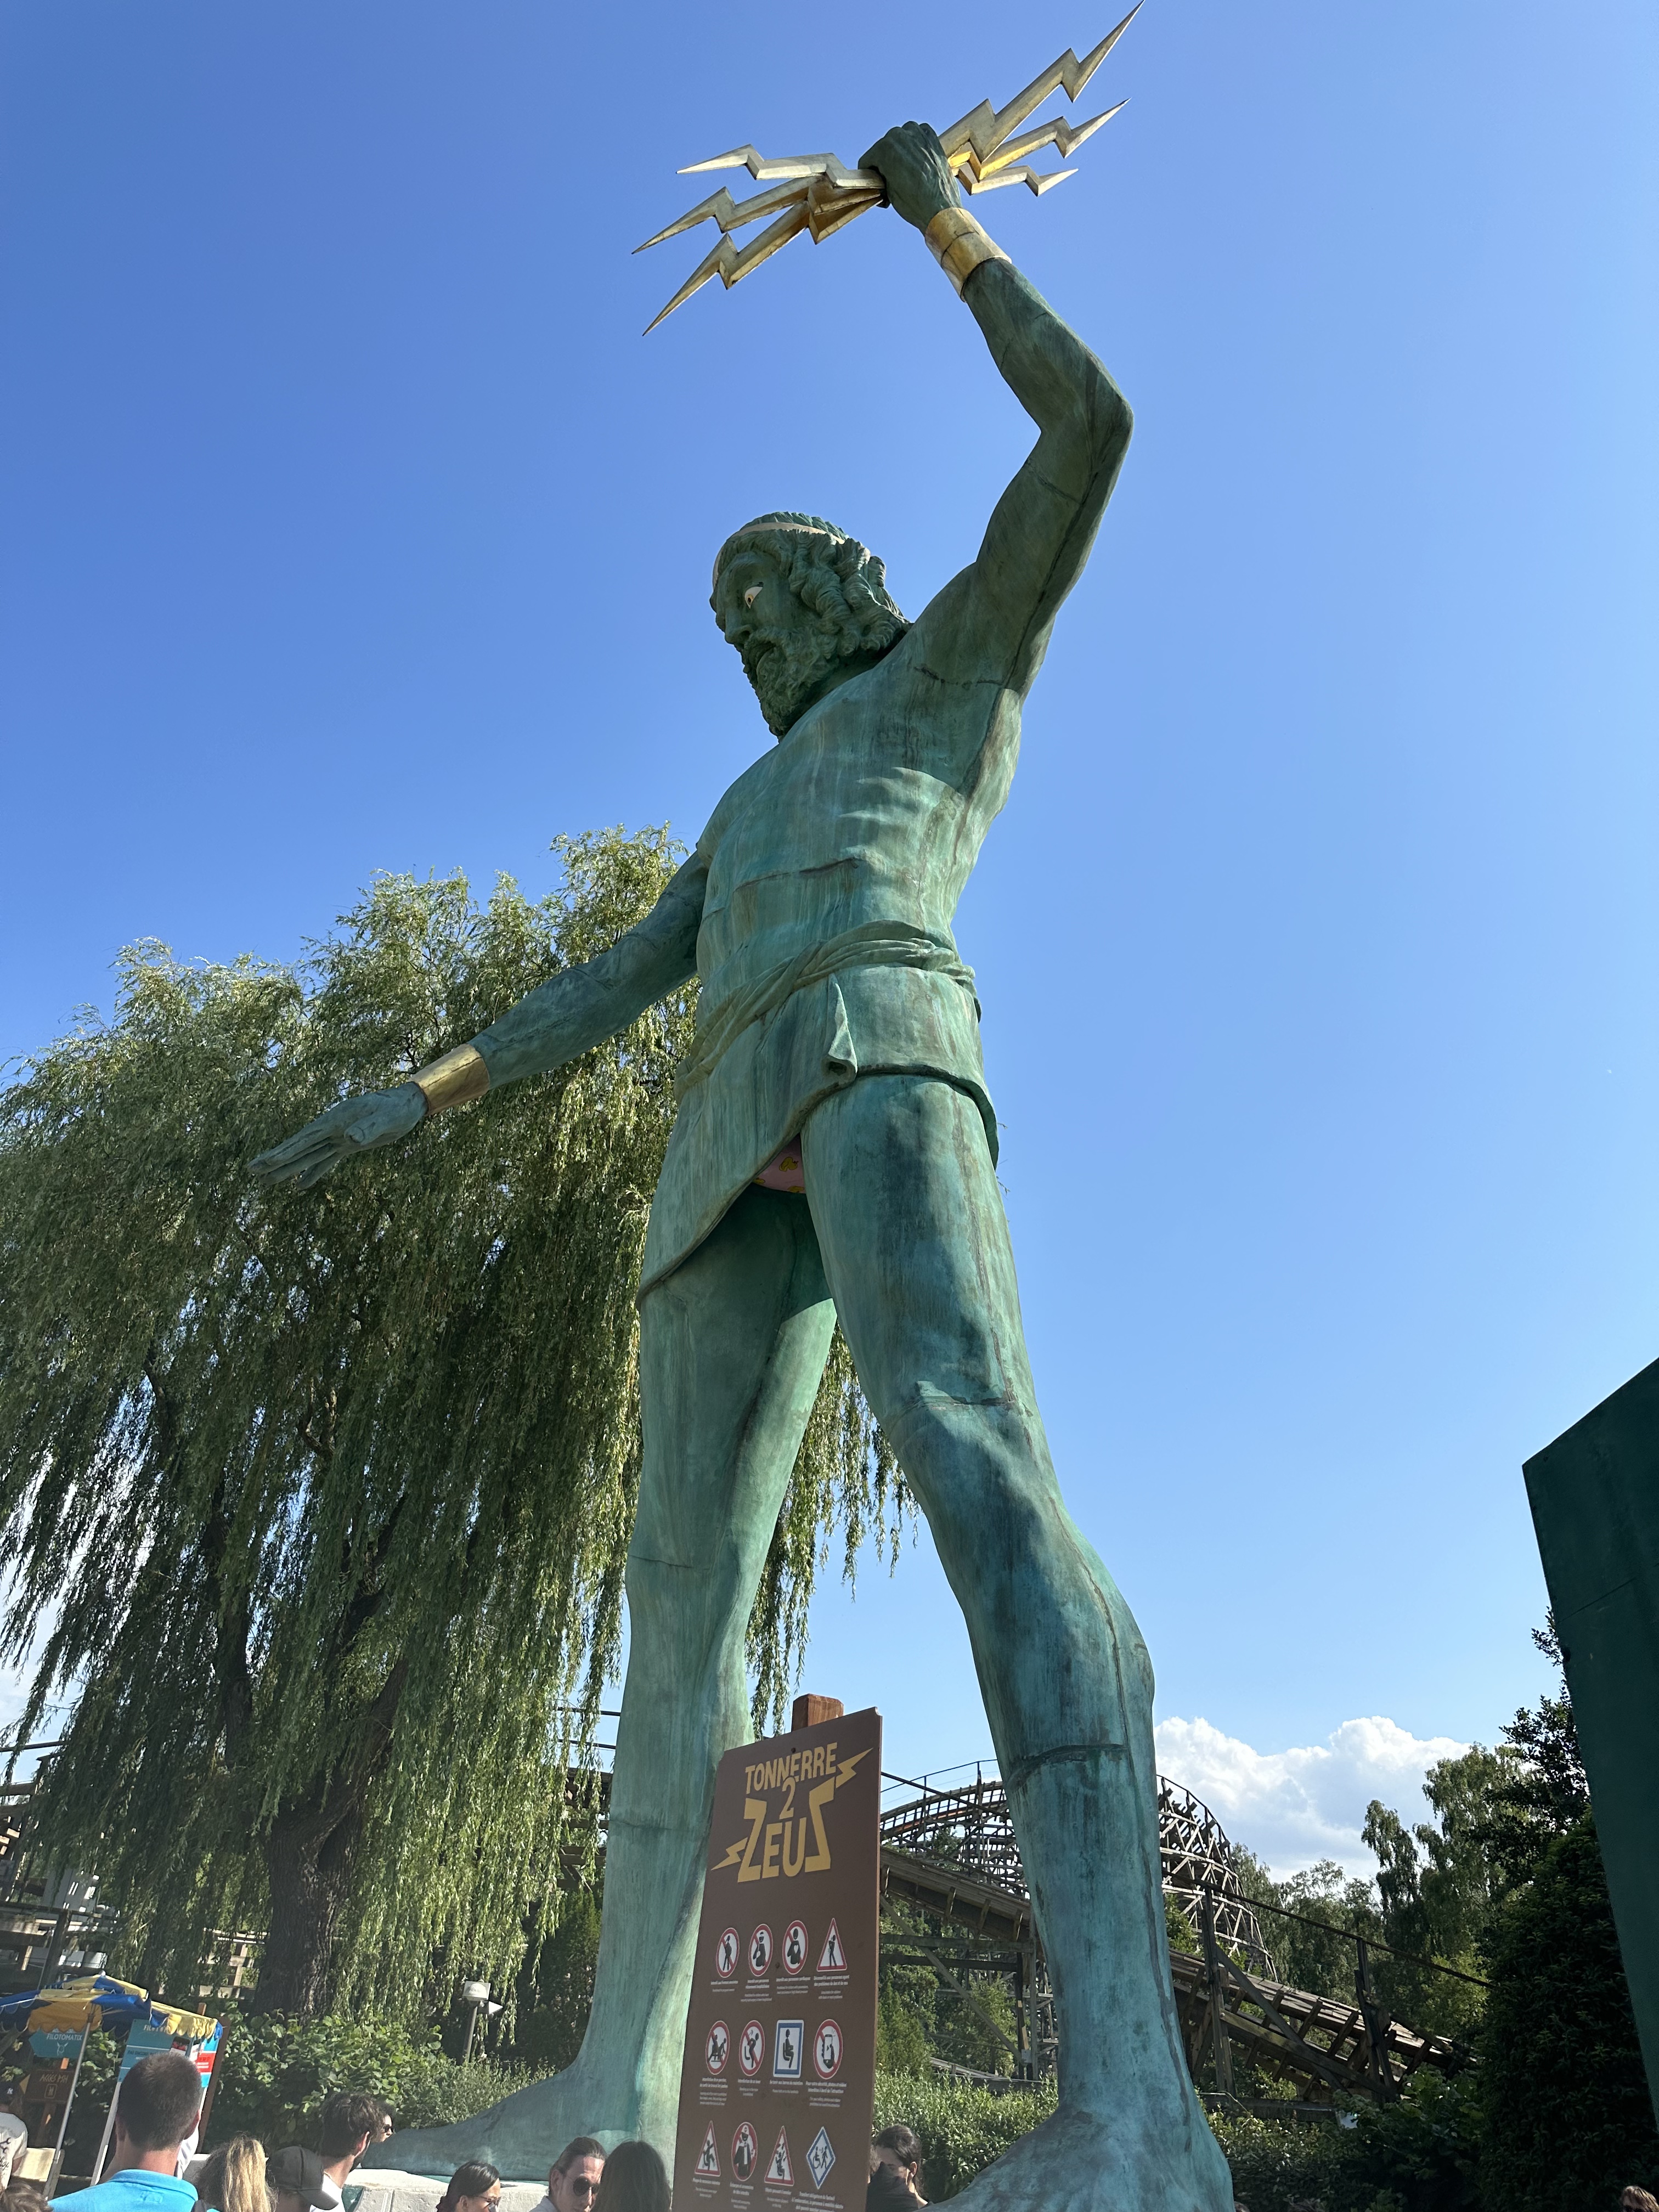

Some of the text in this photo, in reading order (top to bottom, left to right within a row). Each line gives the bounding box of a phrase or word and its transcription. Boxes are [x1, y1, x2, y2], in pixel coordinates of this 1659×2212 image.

[745, 1742, 838, 1795] TONNERRE
[779, 1777, 796, 1820] 2
[737, 1776, 834, 1883] ZEUS
[46, 2033, 83, 2041] FILOTOMATIX
